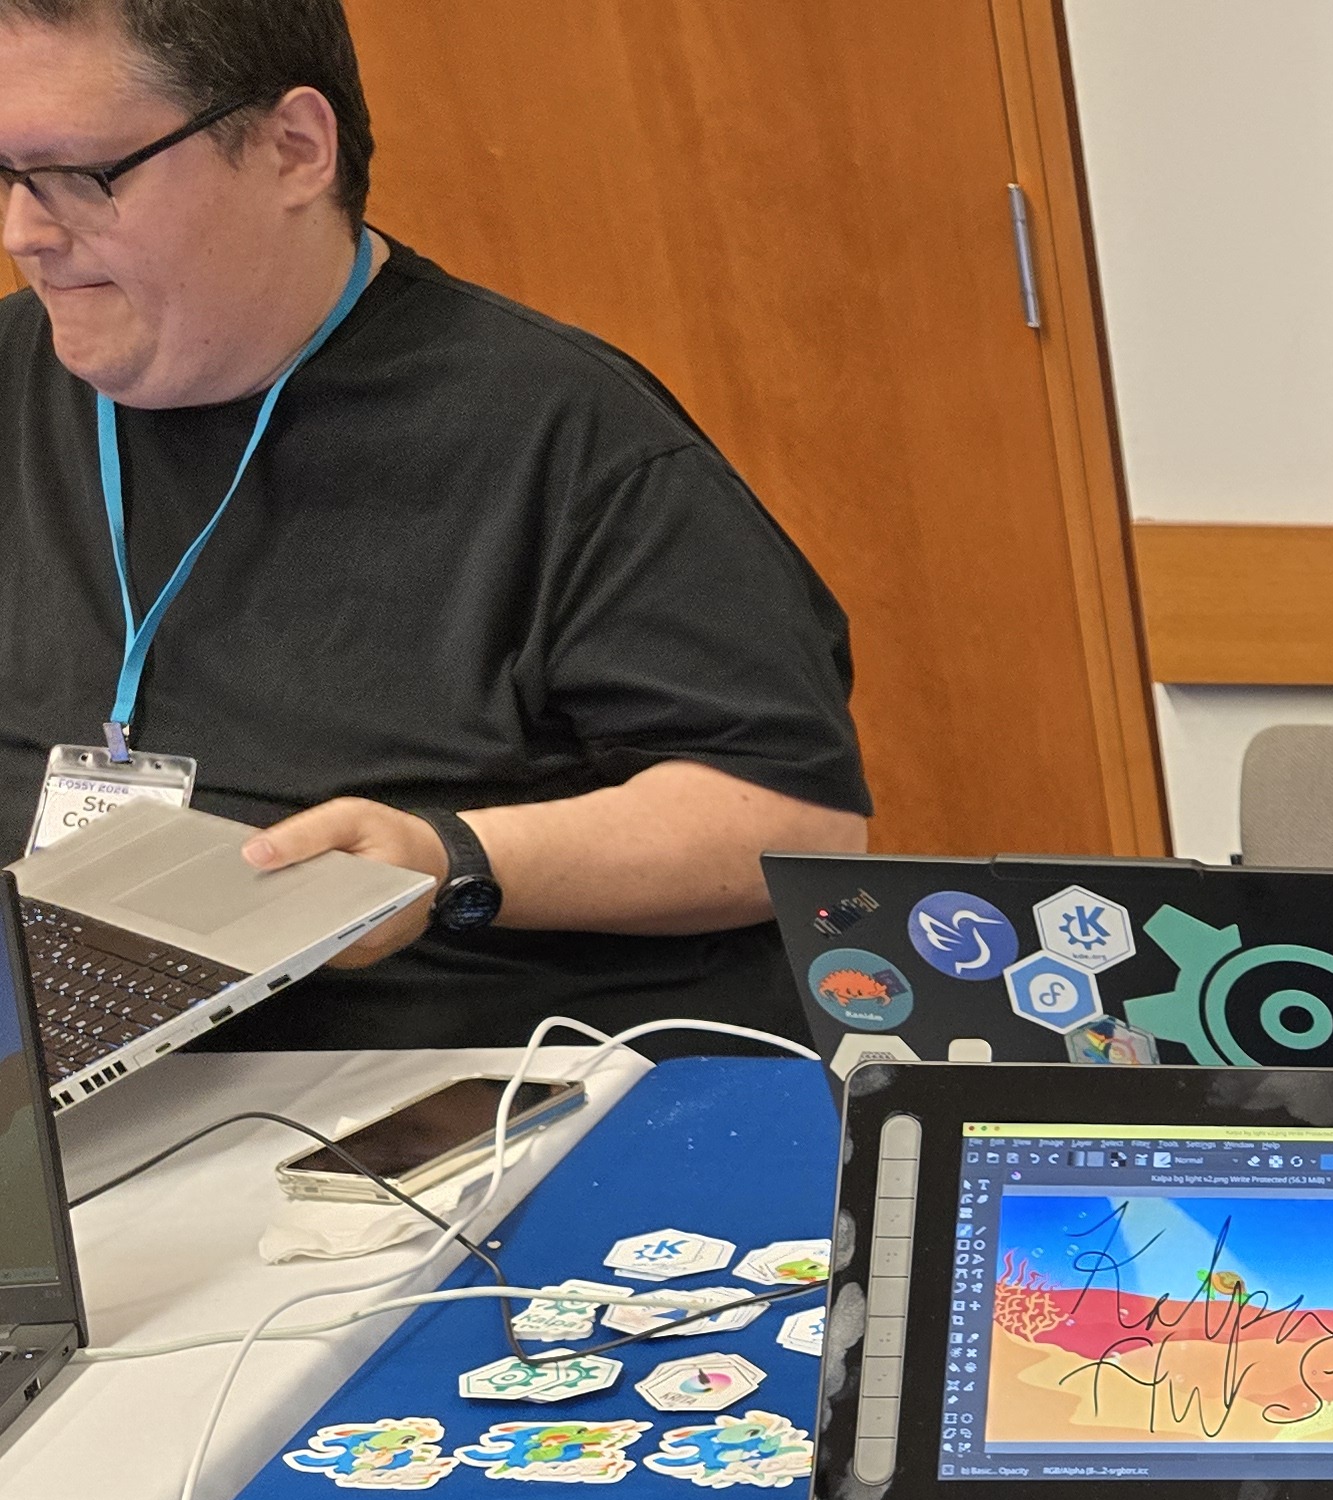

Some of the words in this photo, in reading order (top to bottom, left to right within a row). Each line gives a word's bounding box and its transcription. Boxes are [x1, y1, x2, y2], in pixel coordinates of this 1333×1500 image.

[83, 796, 117, 813] Ste
[63, 811, 89, 829] Co
[1175, 1156, 1203, 1164] Normal
